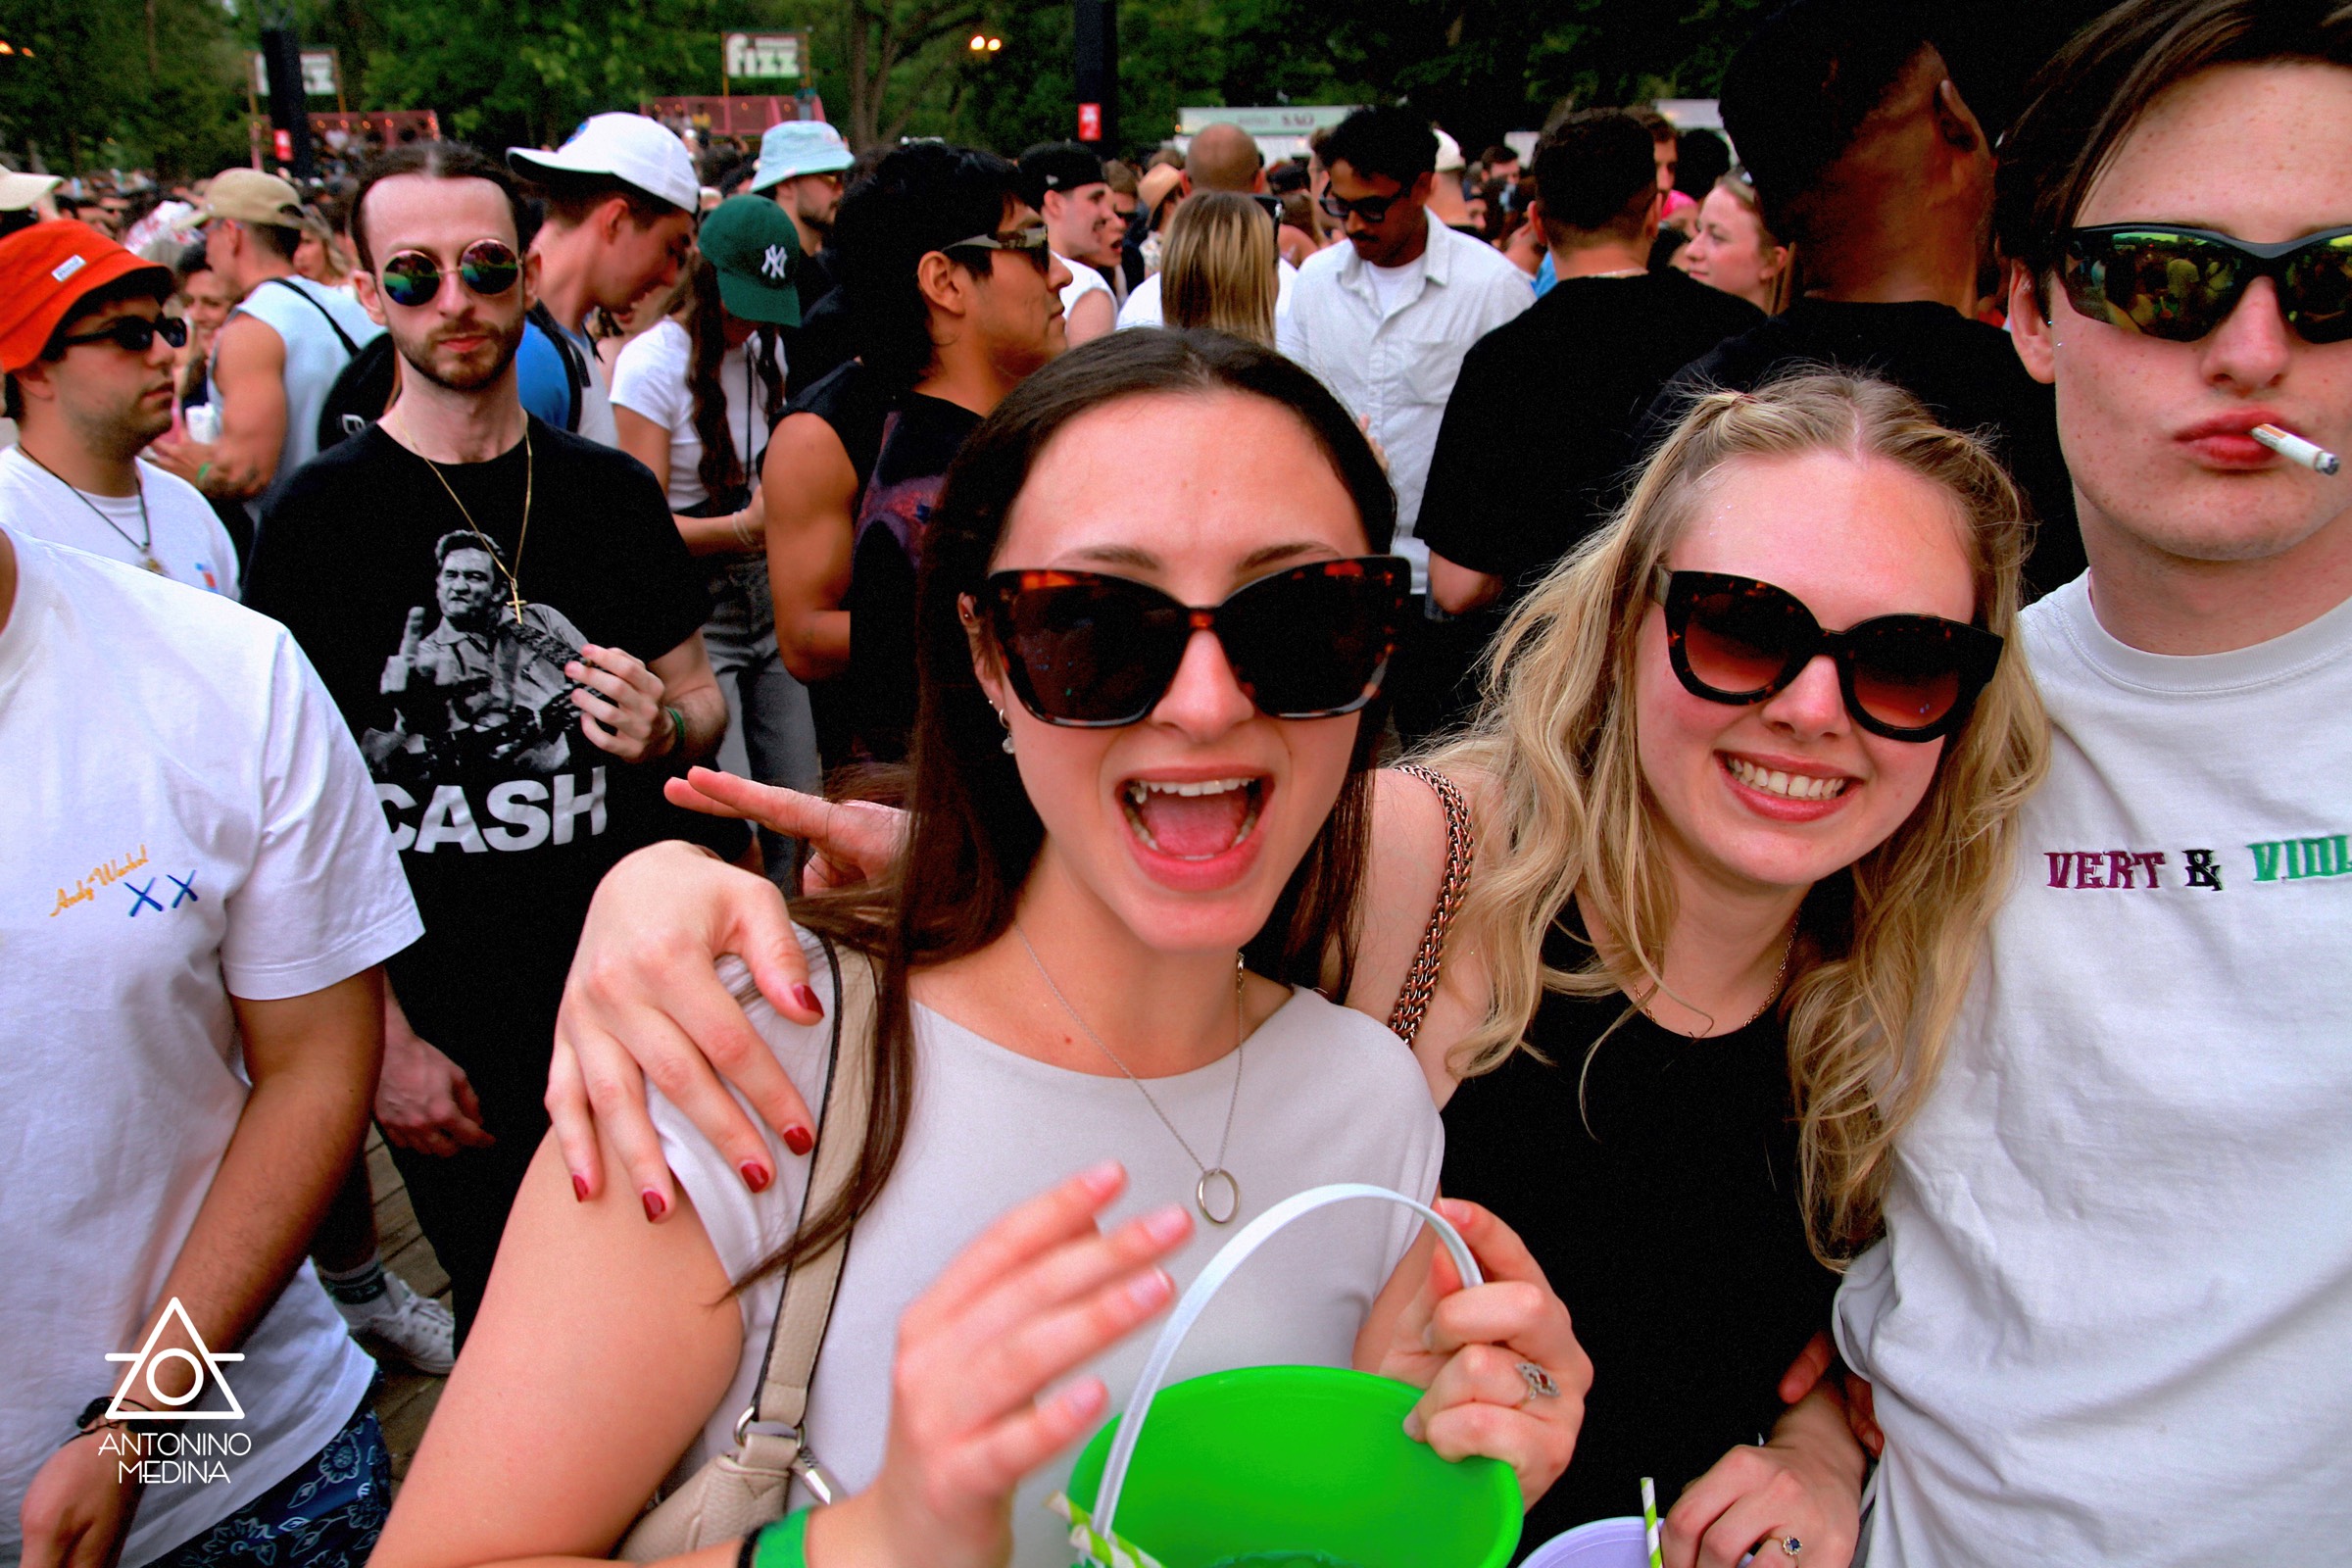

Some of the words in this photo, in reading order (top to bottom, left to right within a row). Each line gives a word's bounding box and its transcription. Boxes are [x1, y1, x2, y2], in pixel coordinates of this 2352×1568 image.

[726, 33, 801, 77] fizz
[761, 243, 788, 278] NY
[375, 765, 608, 853] CASH
[2044, 851, 2165, 889] VERT
